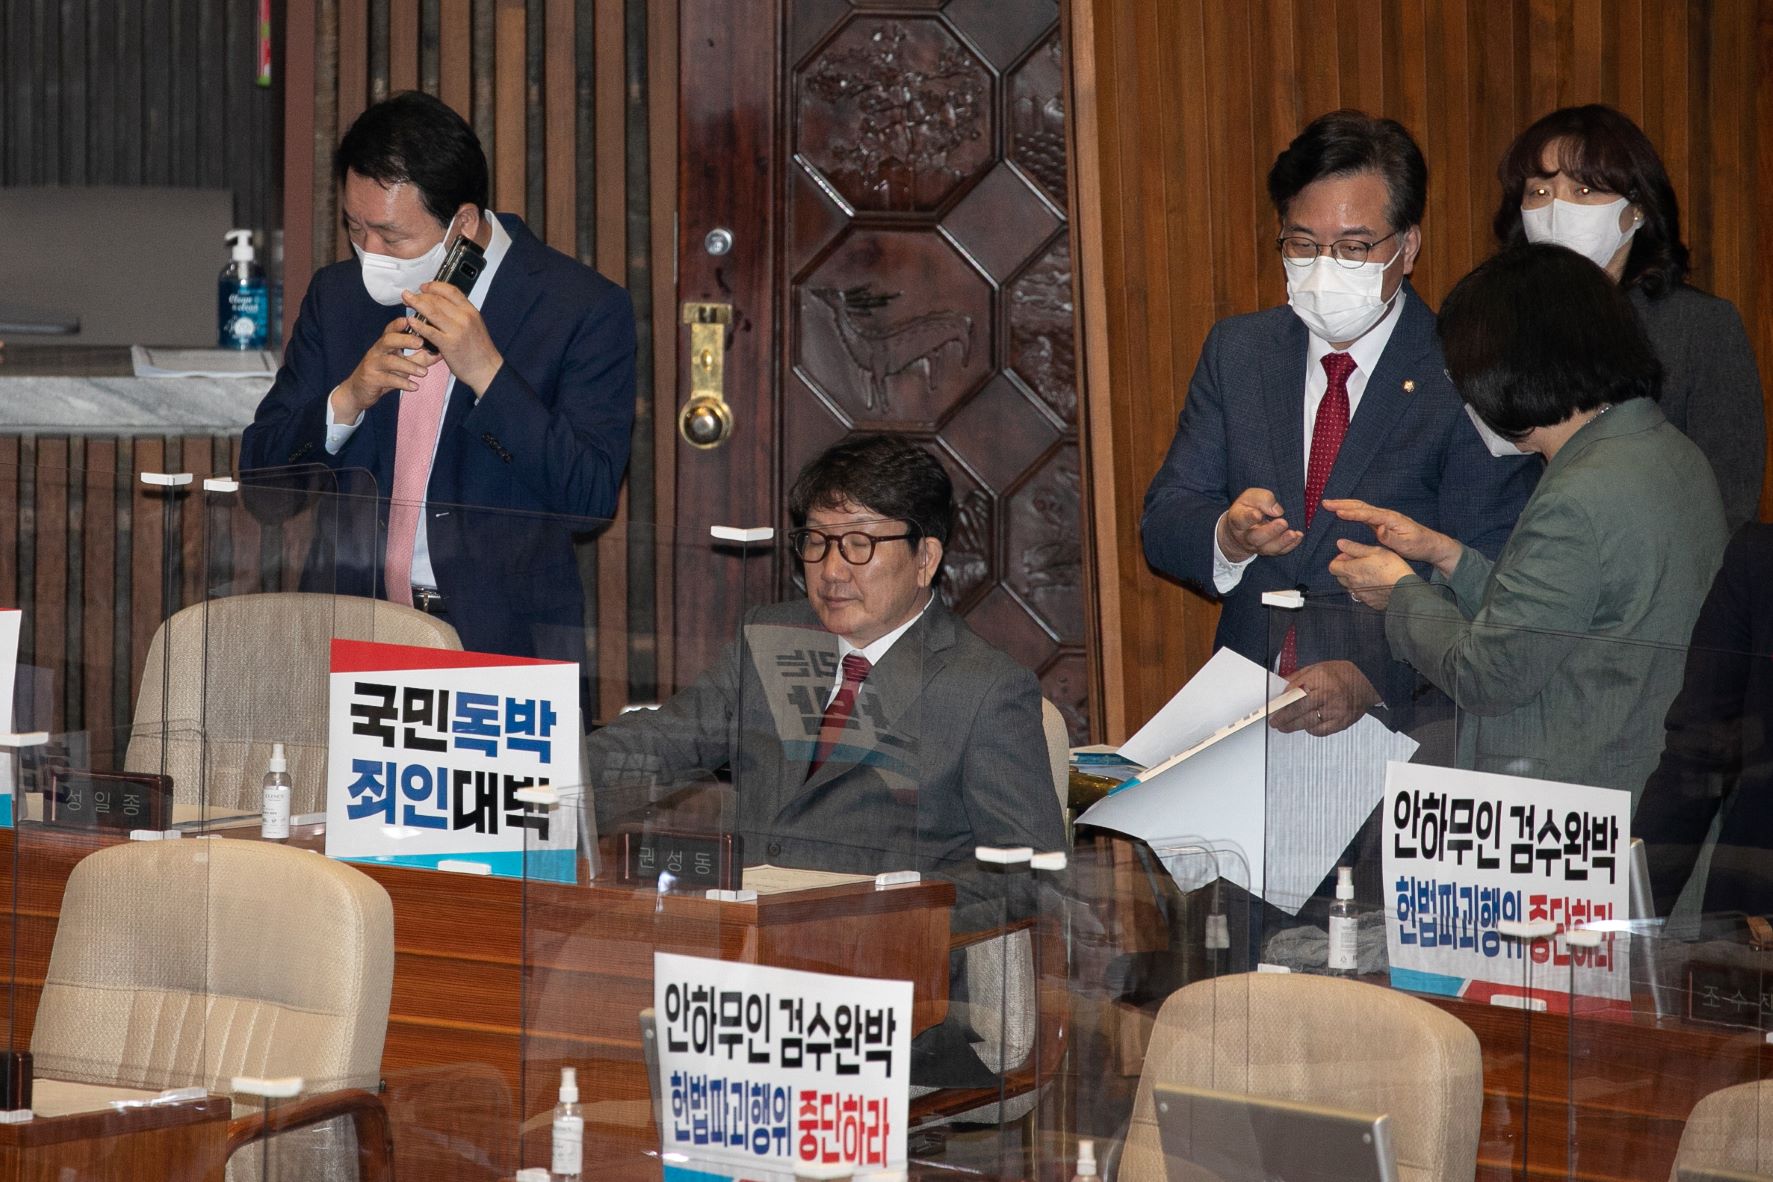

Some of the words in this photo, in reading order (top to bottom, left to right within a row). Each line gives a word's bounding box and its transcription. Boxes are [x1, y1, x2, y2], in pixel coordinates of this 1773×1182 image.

[350, 681, 557, 764] 국민독박
[65, 788, 142, 816] 성일종
[346, 758, 551, 841] 죄인대박
[1393, 789, 1503, 870] 안하무인
[1509, 804, 1619, 885] 검수완박
[638, 846, 712, 875] 권성동
[1395, 875, 1522, 960] 헌법파괴행위
[665, 982, 771, 1064] 안하무인
[779, 997, 897, 1079] 검수완박
[670, 1070, 792, 1157] 헌법파괴행위
[798, 1088, 890, 1168] 중단하라
